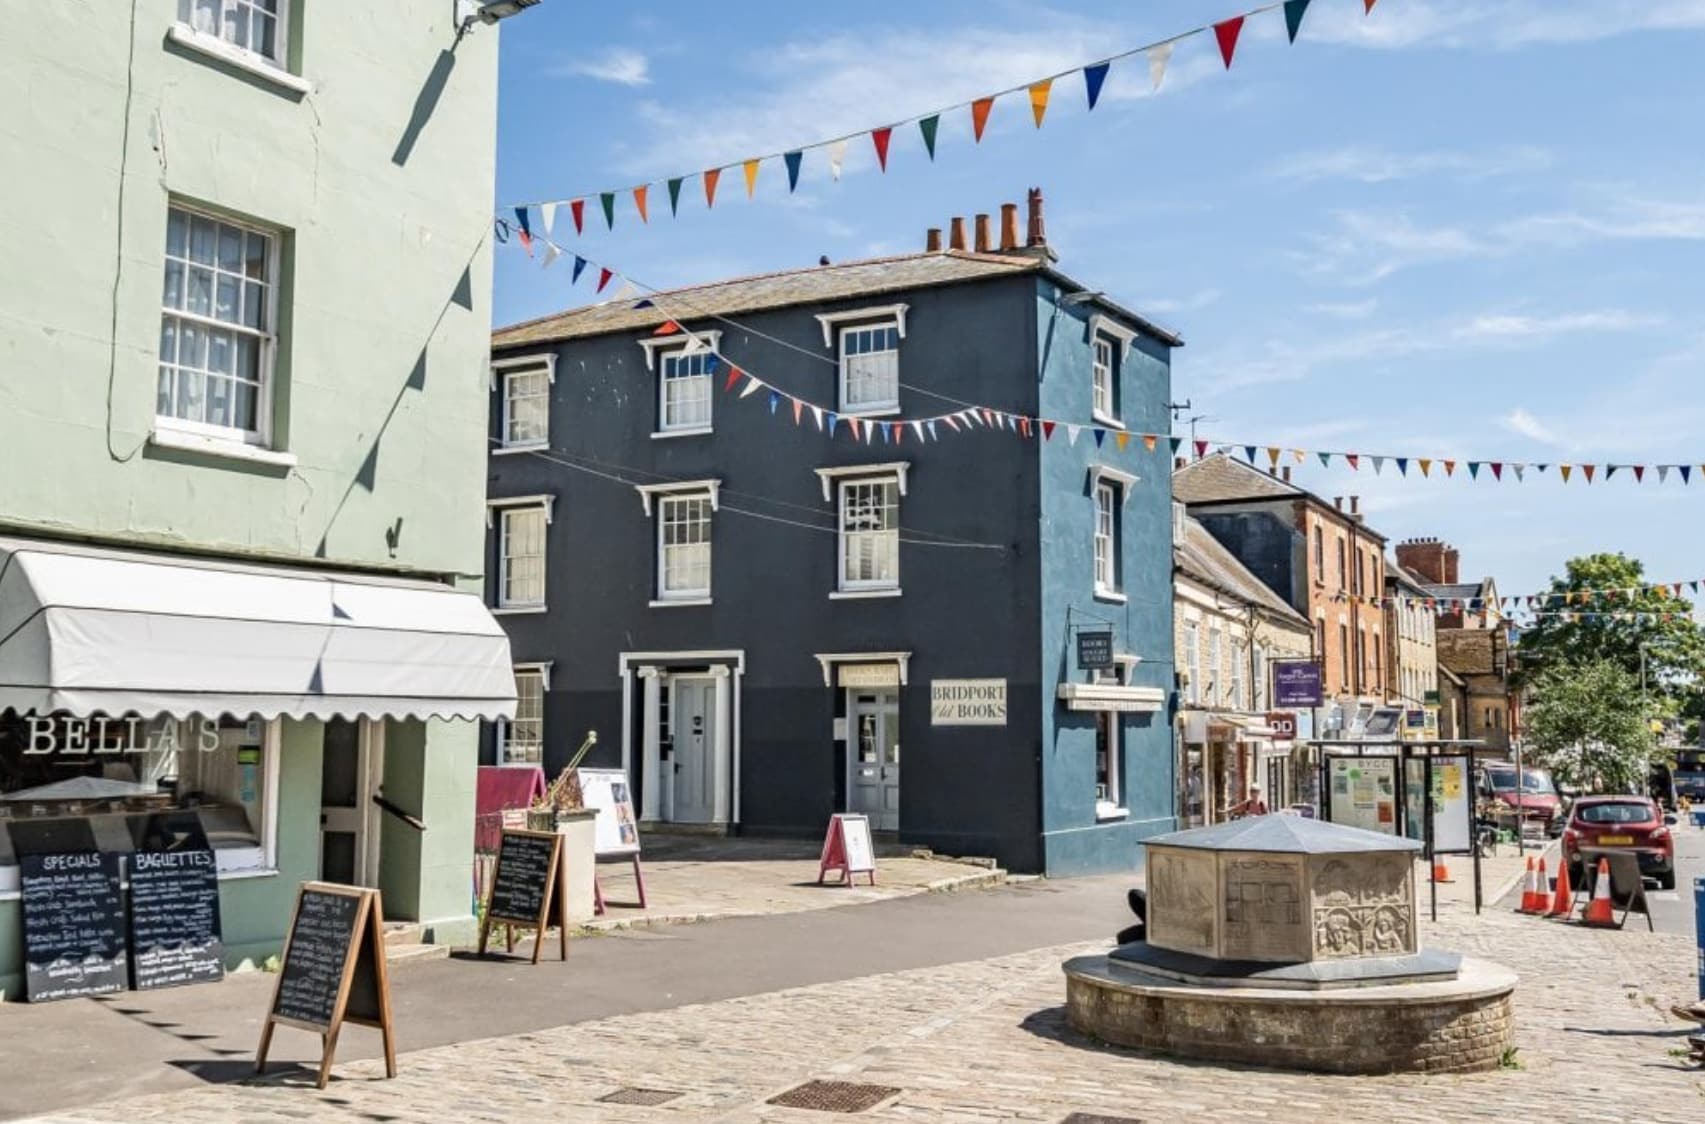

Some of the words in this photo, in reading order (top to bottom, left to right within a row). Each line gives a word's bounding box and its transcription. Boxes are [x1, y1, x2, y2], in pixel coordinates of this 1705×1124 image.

[933, 686, 1005, 701] BRIDPORT
[958, 703, 1006, 718] BOOKS
[24, 717, 220, 755] BELLA'S
[43, 852, 101, 870] SPECIALS
[135, 851, 210, 870] BAGUETTES
